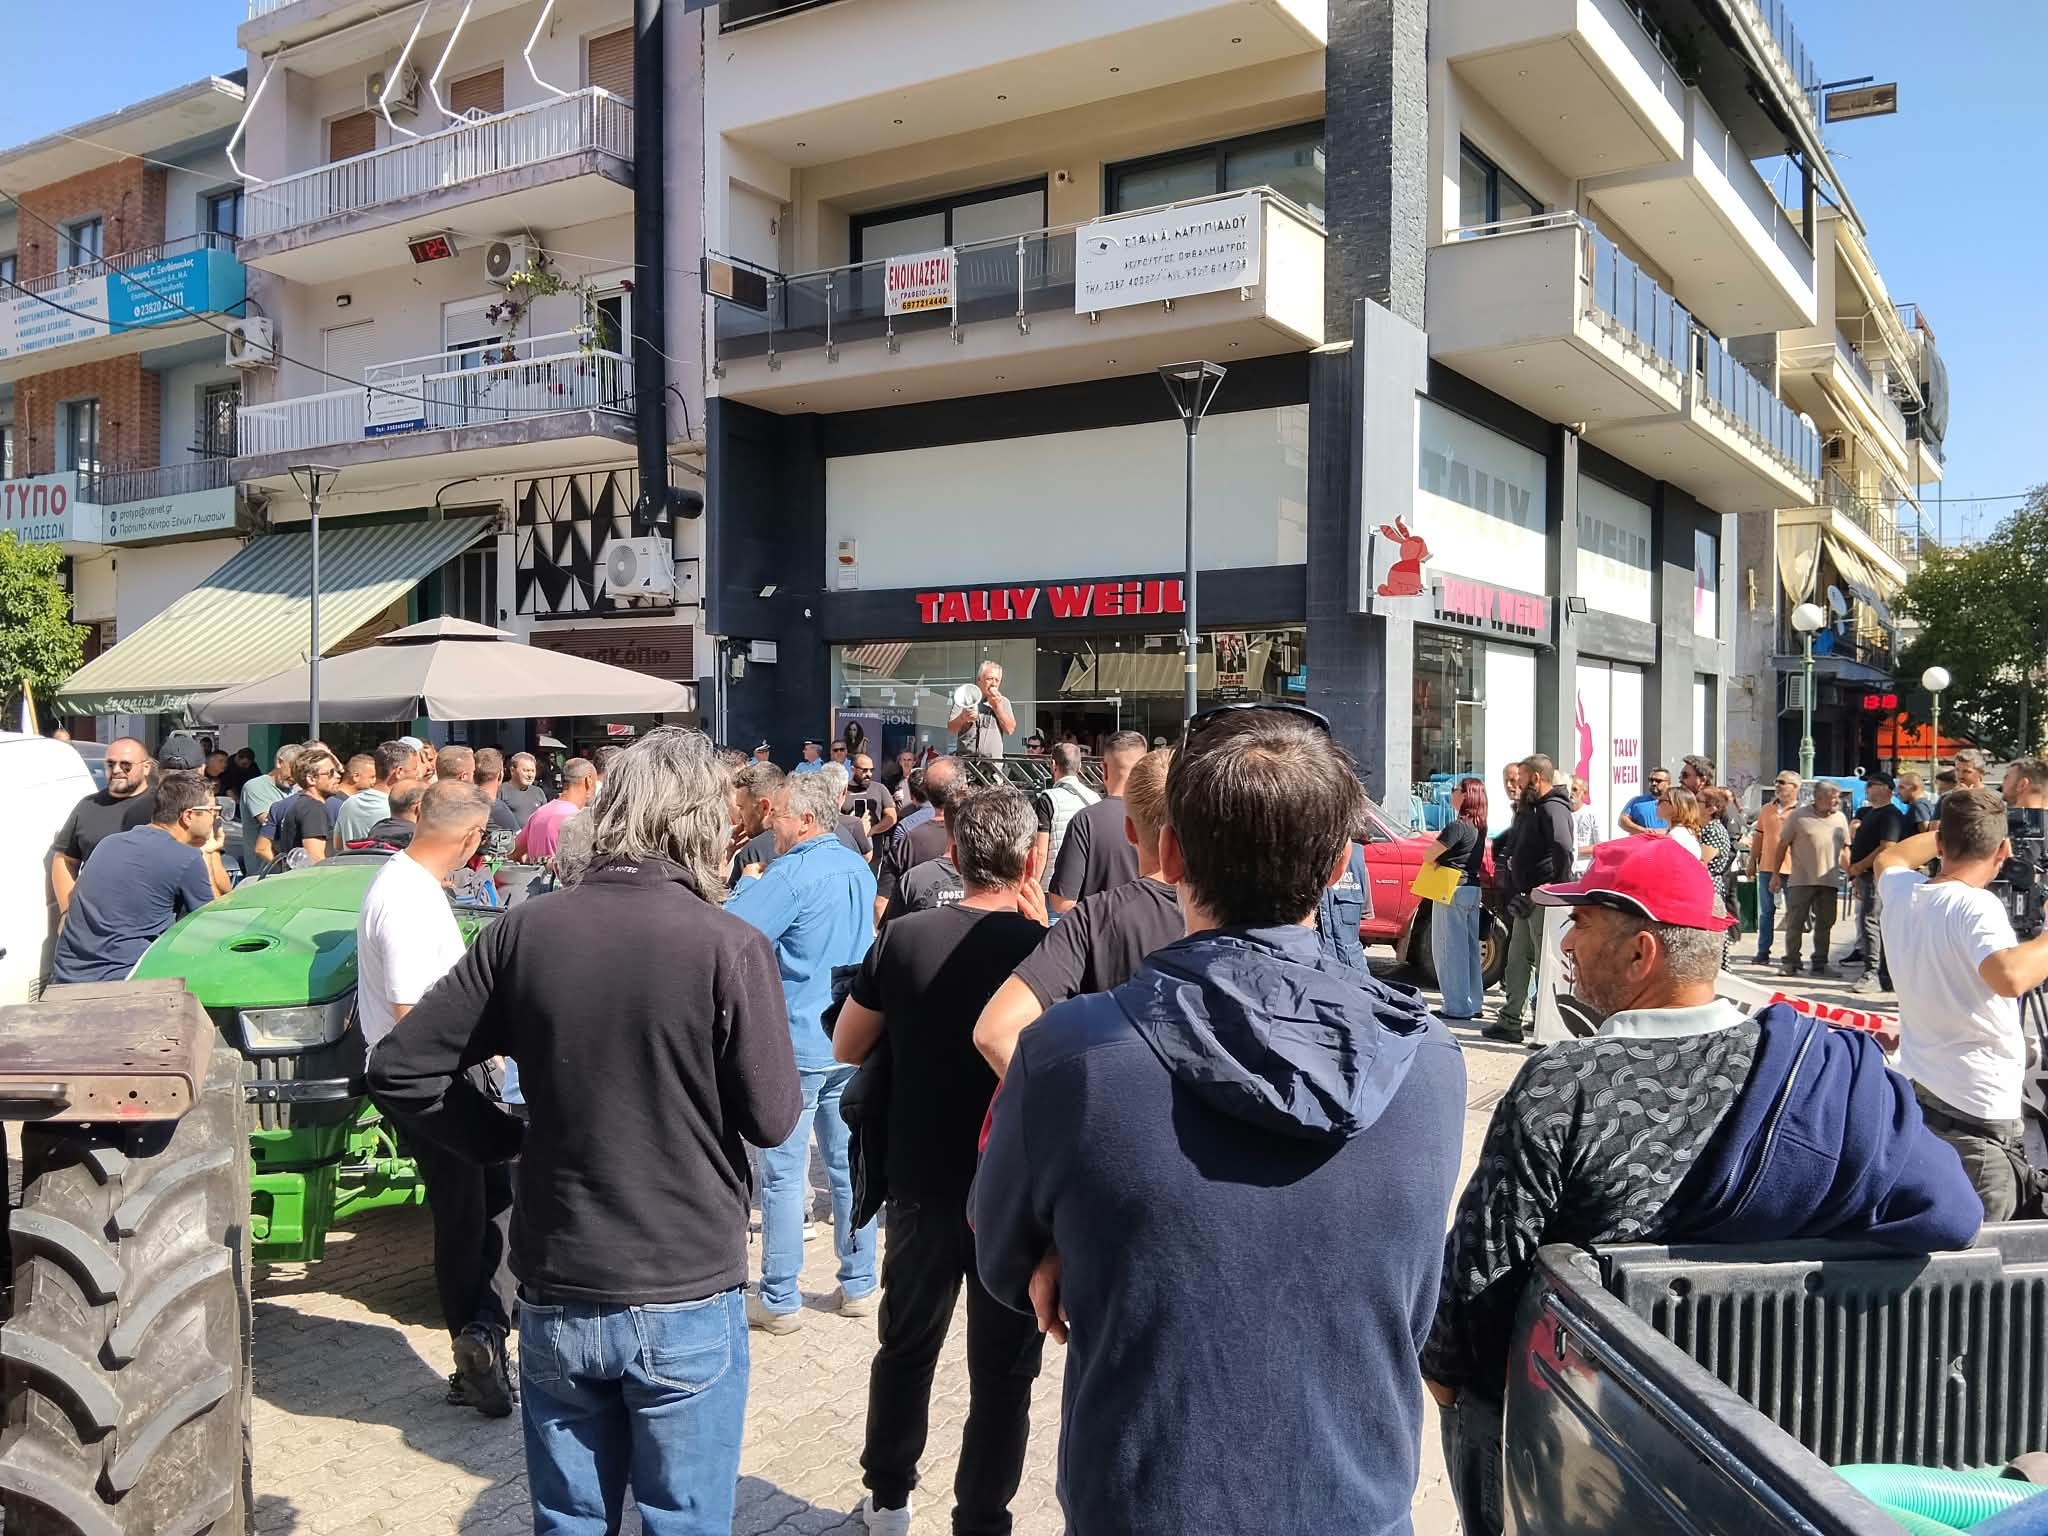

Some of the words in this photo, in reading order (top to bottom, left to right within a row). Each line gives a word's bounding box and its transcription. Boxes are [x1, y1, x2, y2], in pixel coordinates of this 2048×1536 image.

[889, 258, 950, 291] ΕΝΟΙΚΙΑΖΕΤΑΙ
[141, 301, 162, 317] 23820
[902, 296, 948, 310] 6977214440
[0, 484, 67, 520] ΤΥΠΟ
[23, 522, 65, 540] ΓΛΩΣΣΩΝ
[916, 588, 1040, 623] TALLY
[1441, 576, 1495, 619] TALLY
[1613, 738, 1638, 758] TALLY
